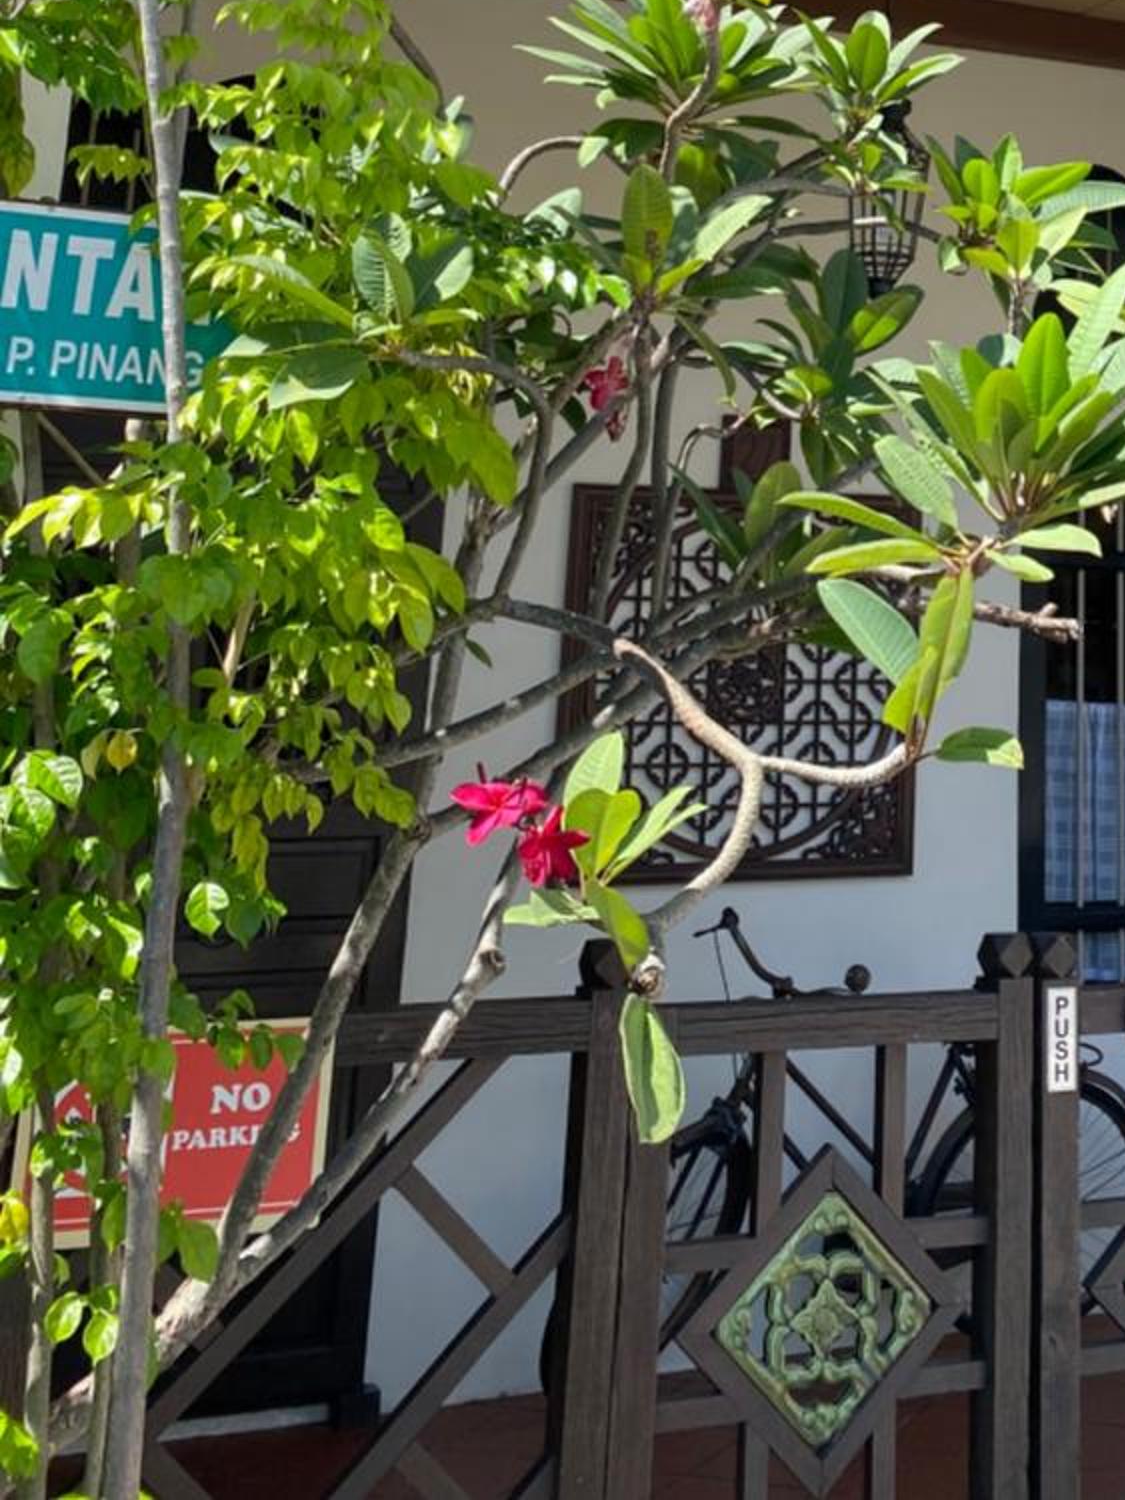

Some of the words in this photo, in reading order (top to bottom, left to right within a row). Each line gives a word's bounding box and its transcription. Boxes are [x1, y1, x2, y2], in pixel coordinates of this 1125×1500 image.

[0, 228, 209, 326] NTA
[6, 335, 34, 376] P.
[1054, 996, 1069, 1082] PUSH
[210, 1081, 271, 1114] NO
[172, 1122, 301, 1151] PARKI
